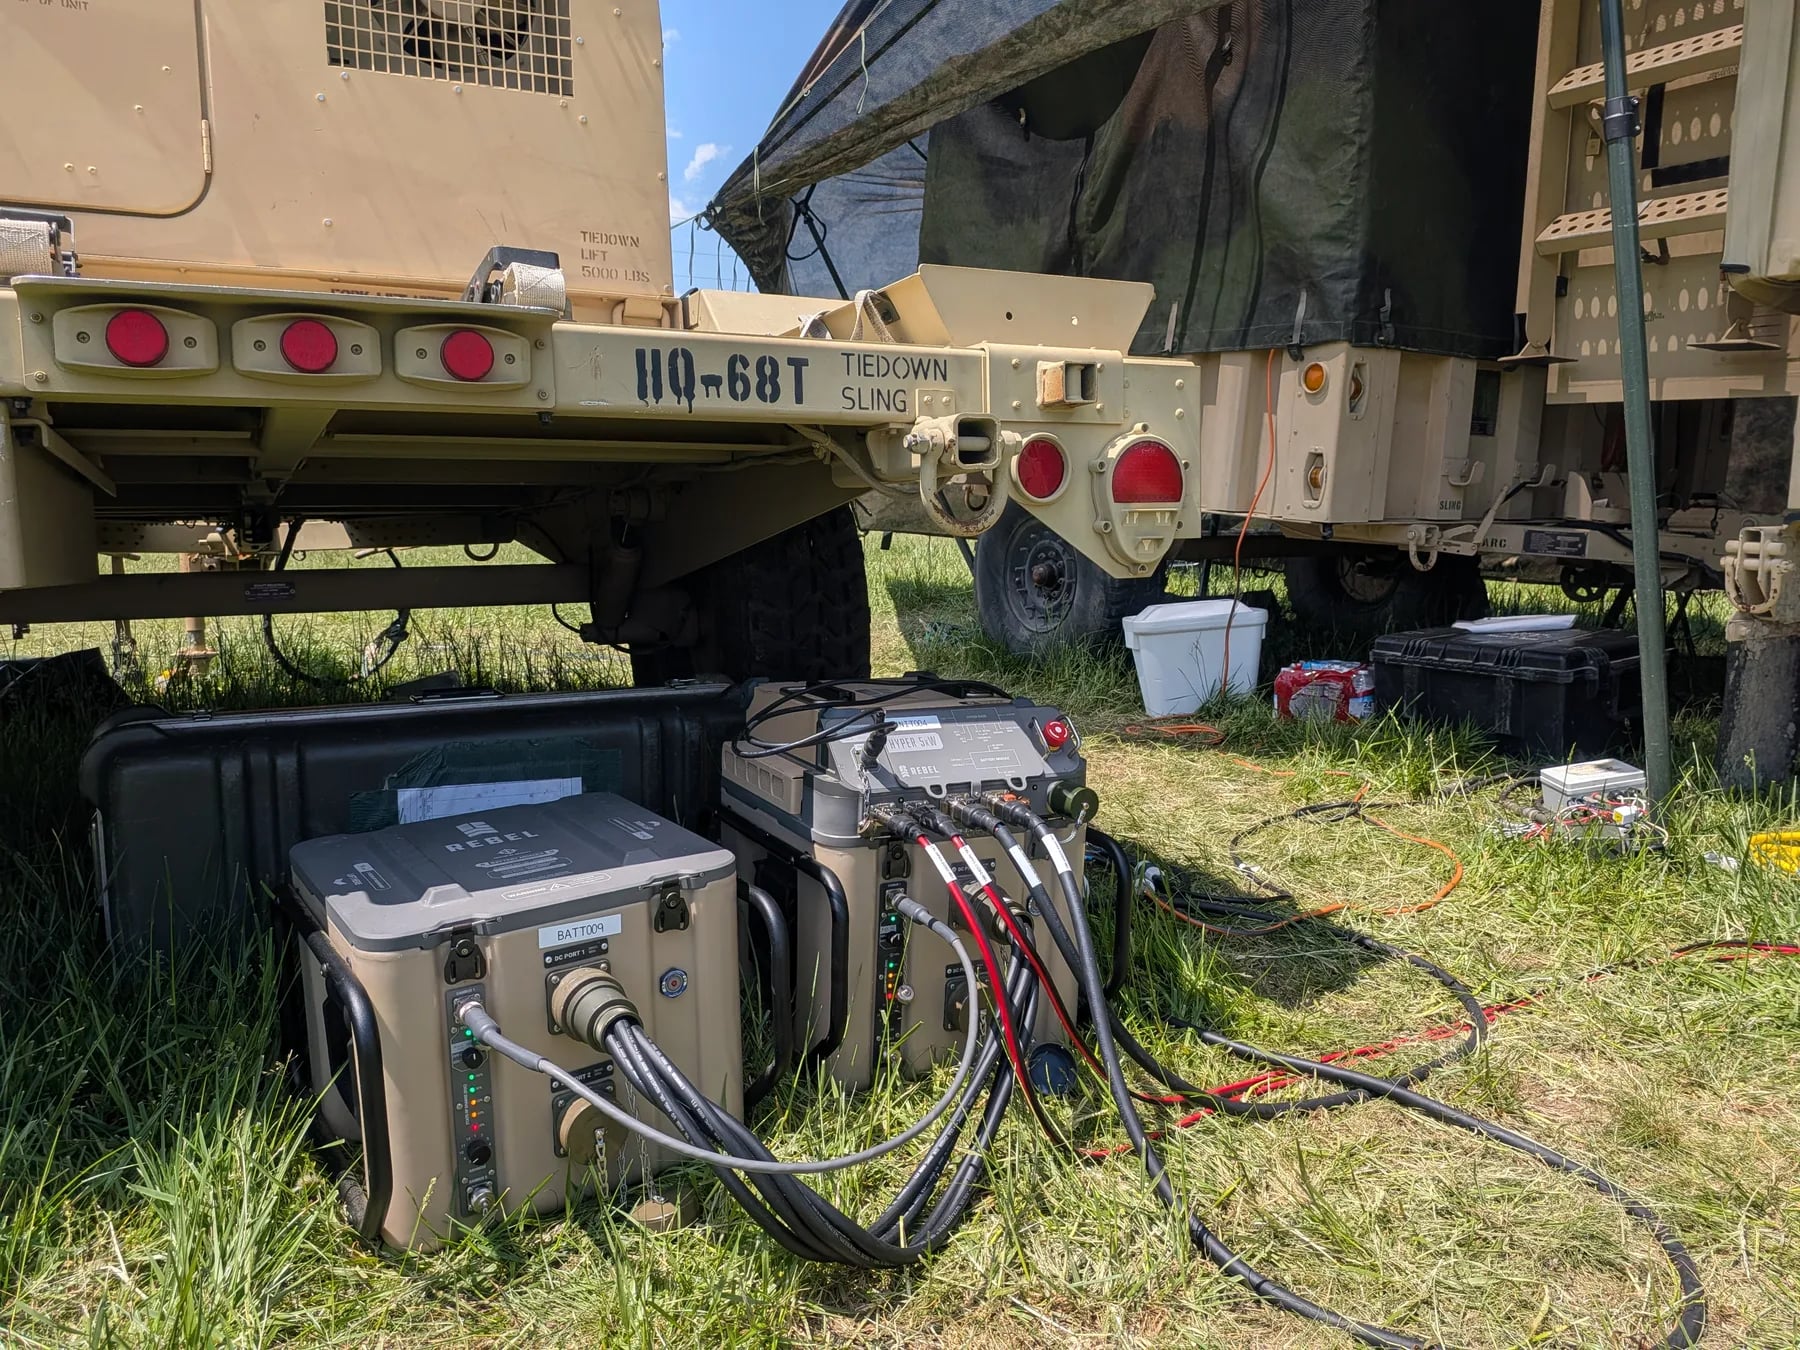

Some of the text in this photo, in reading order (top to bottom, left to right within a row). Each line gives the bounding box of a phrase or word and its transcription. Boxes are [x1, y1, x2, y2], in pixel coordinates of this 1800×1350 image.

[580, 230, 640, 248] TIEDOWN
[581, 247, 608, 261] LIFT
[582, 265, 650, 283] 5000 LBS
[841, 352, 948, 382] TIEDOWN
[841, 386, 908, 413] SLING
[1439, 500, 1462, 511] SLING
[888, 736, 917, 751] HYPER
[910, 765, 940, 776] REBEL
[445, 830, 540, 852] REBEL
[557, 922, 605, 942] BATT009
[554, 953, 564, 962] DC
[564, 950, 581, 960] PORT
